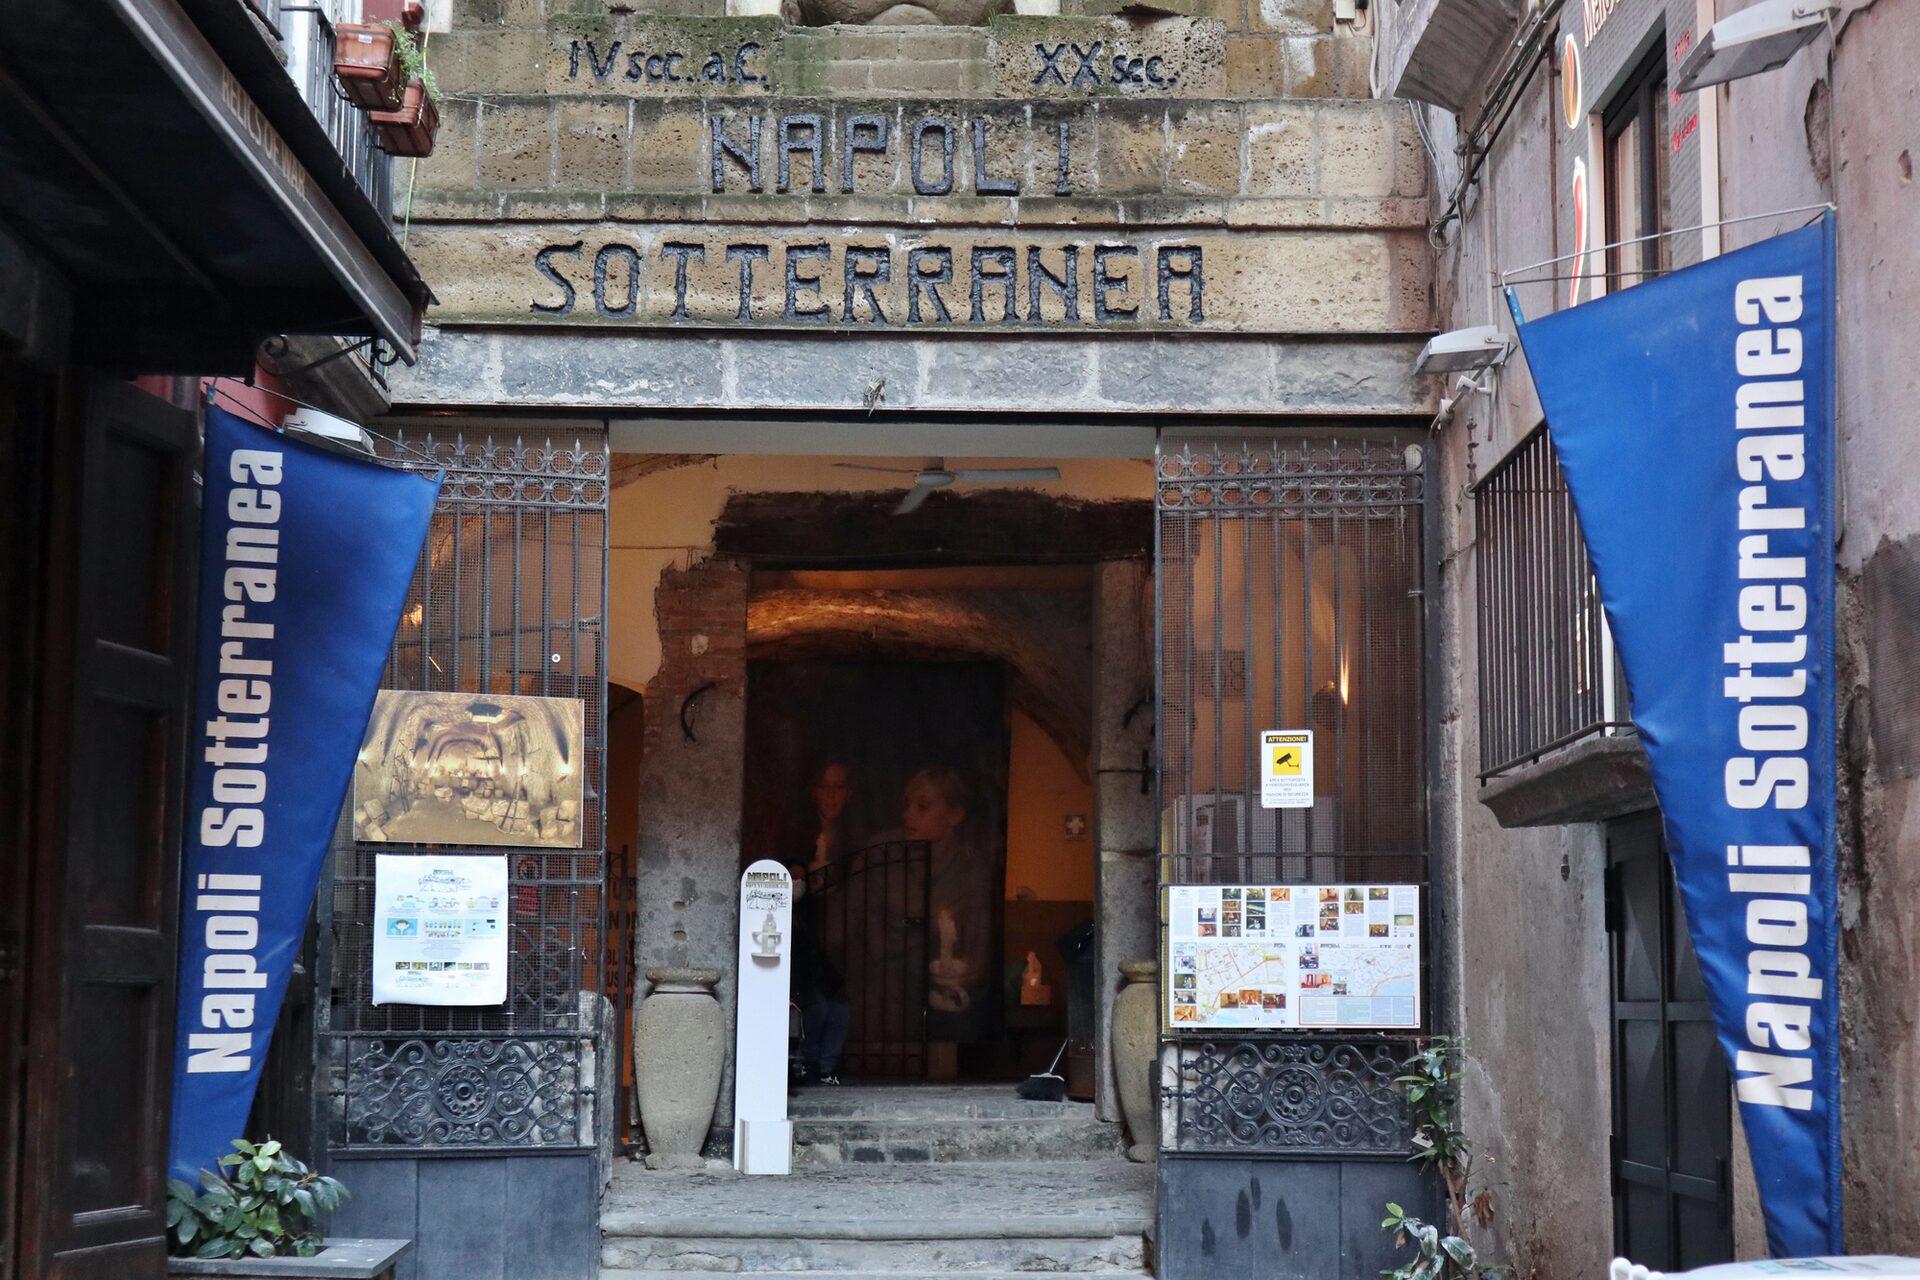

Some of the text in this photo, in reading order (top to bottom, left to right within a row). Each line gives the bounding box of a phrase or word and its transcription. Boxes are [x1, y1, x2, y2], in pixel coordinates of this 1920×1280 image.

[568, 40, 622, 83] IV
[1031, 40, 1178, 90] XX sec.
[222, 67, 261, 146] RELICS
[264, 119, 283, 166] OF
[710, 113, 1073, 198] NAPOLI
[529, 239, 1206, 324] SOTTERRANEA
[1724, 274, 1823, 1112] Napoli Sotterranea
[187, 448, 283, 1074] Napoli Sotterranea
